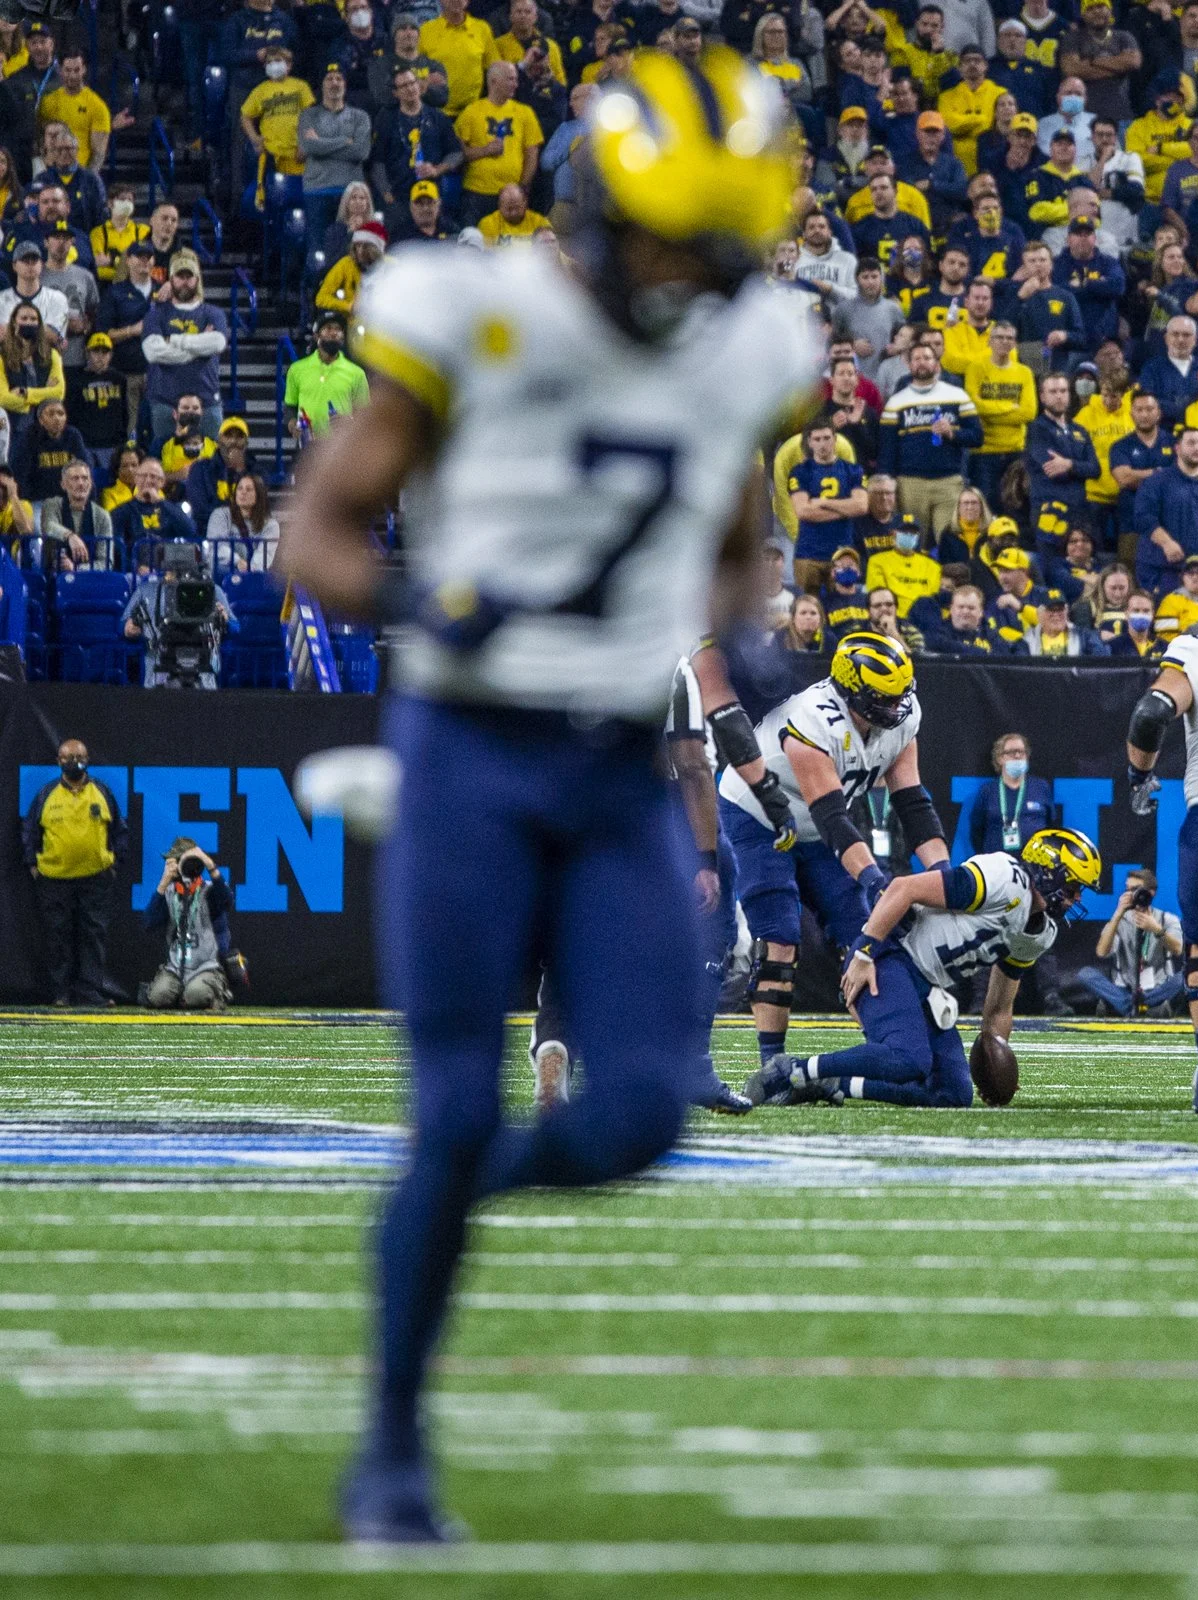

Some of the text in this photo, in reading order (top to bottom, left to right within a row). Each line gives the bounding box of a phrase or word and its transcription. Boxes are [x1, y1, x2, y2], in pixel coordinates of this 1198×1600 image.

[819, 476, 840, 499] 2
[568, 432, 679, 616] 7
[816, 698, 846, 727] 71
